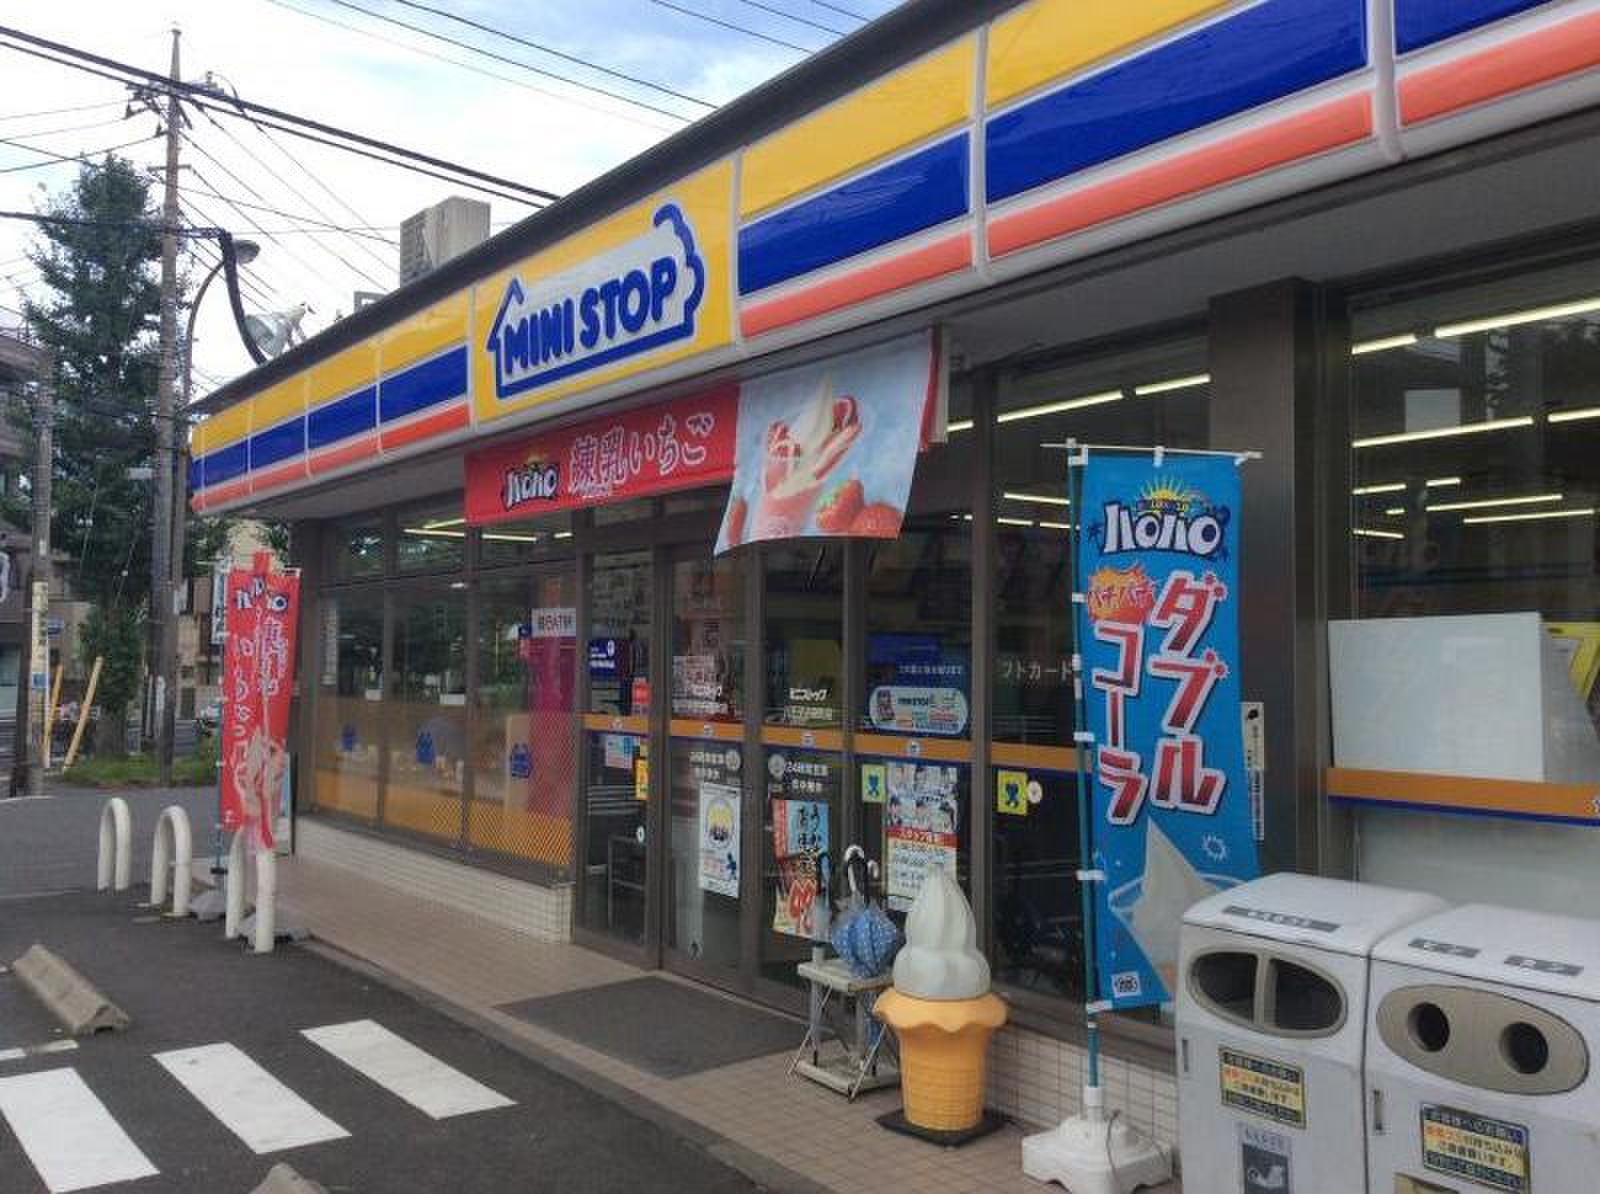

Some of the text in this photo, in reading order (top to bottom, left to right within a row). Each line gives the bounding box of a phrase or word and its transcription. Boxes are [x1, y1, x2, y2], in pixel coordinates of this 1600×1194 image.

[503, 256, 677, 375] MINI STOP
[1102, 501, 1222, 556] ハロハロ
[1092, 620, 1147, 825] コーラ
[1146, 569, 1227, 815] ダブル
